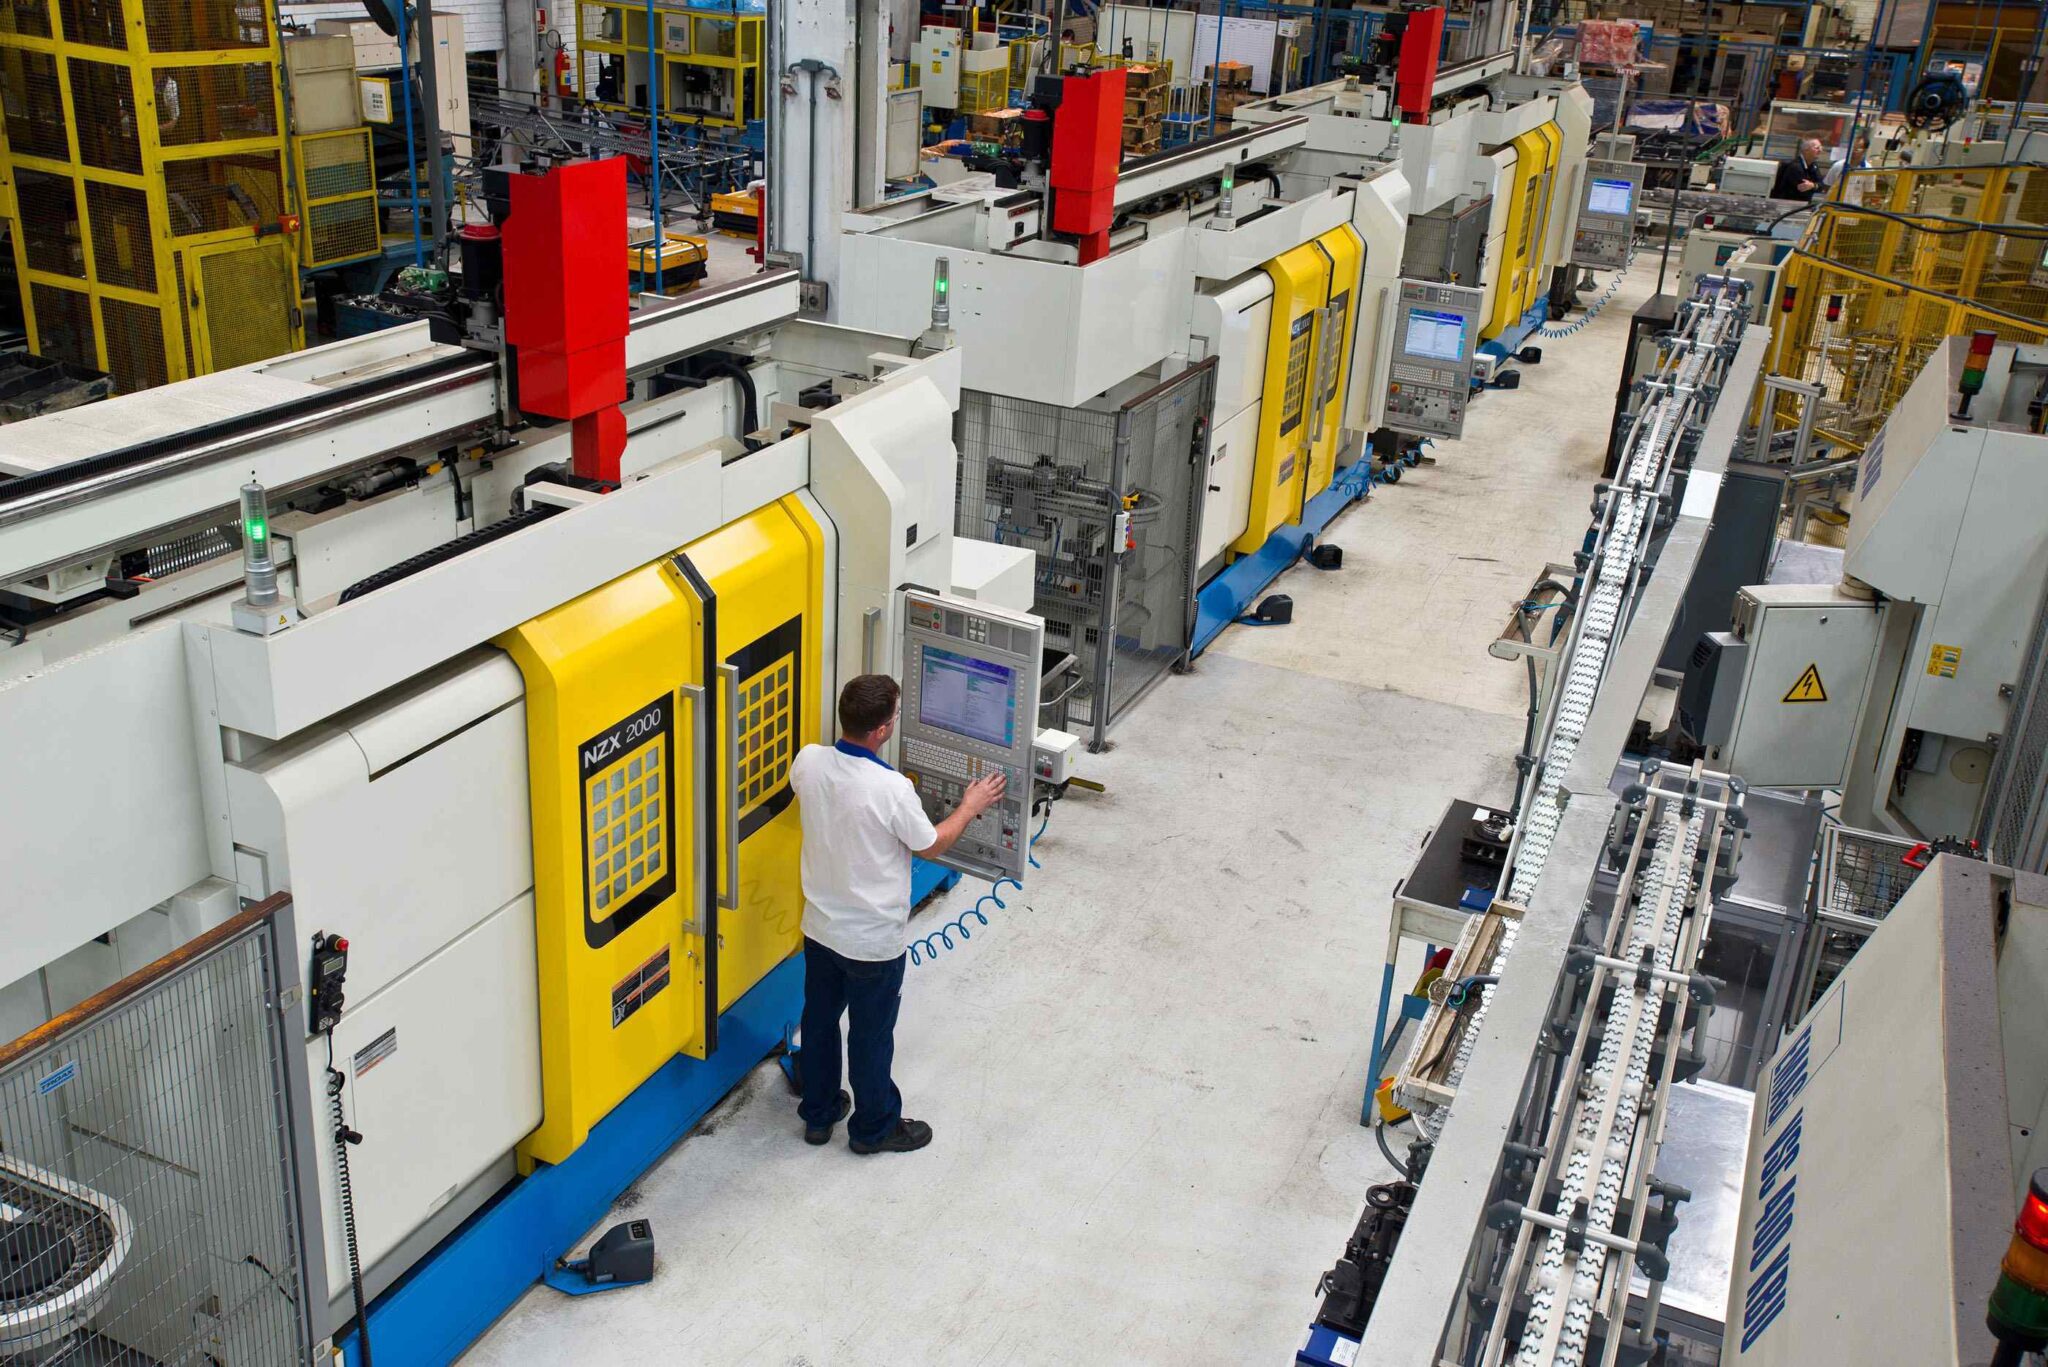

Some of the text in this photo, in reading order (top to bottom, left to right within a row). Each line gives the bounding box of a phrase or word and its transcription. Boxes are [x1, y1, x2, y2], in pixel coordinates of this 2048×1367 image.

[1616, 68, 1640, 76] SETUP
[584, 708, 661, 769] NZX 2000
[1767, 1024, 1812, 1128] EMAG
[1759, 1106, 1804, 1201] VSC
[1750, 1174, 1797, 1273] 400
